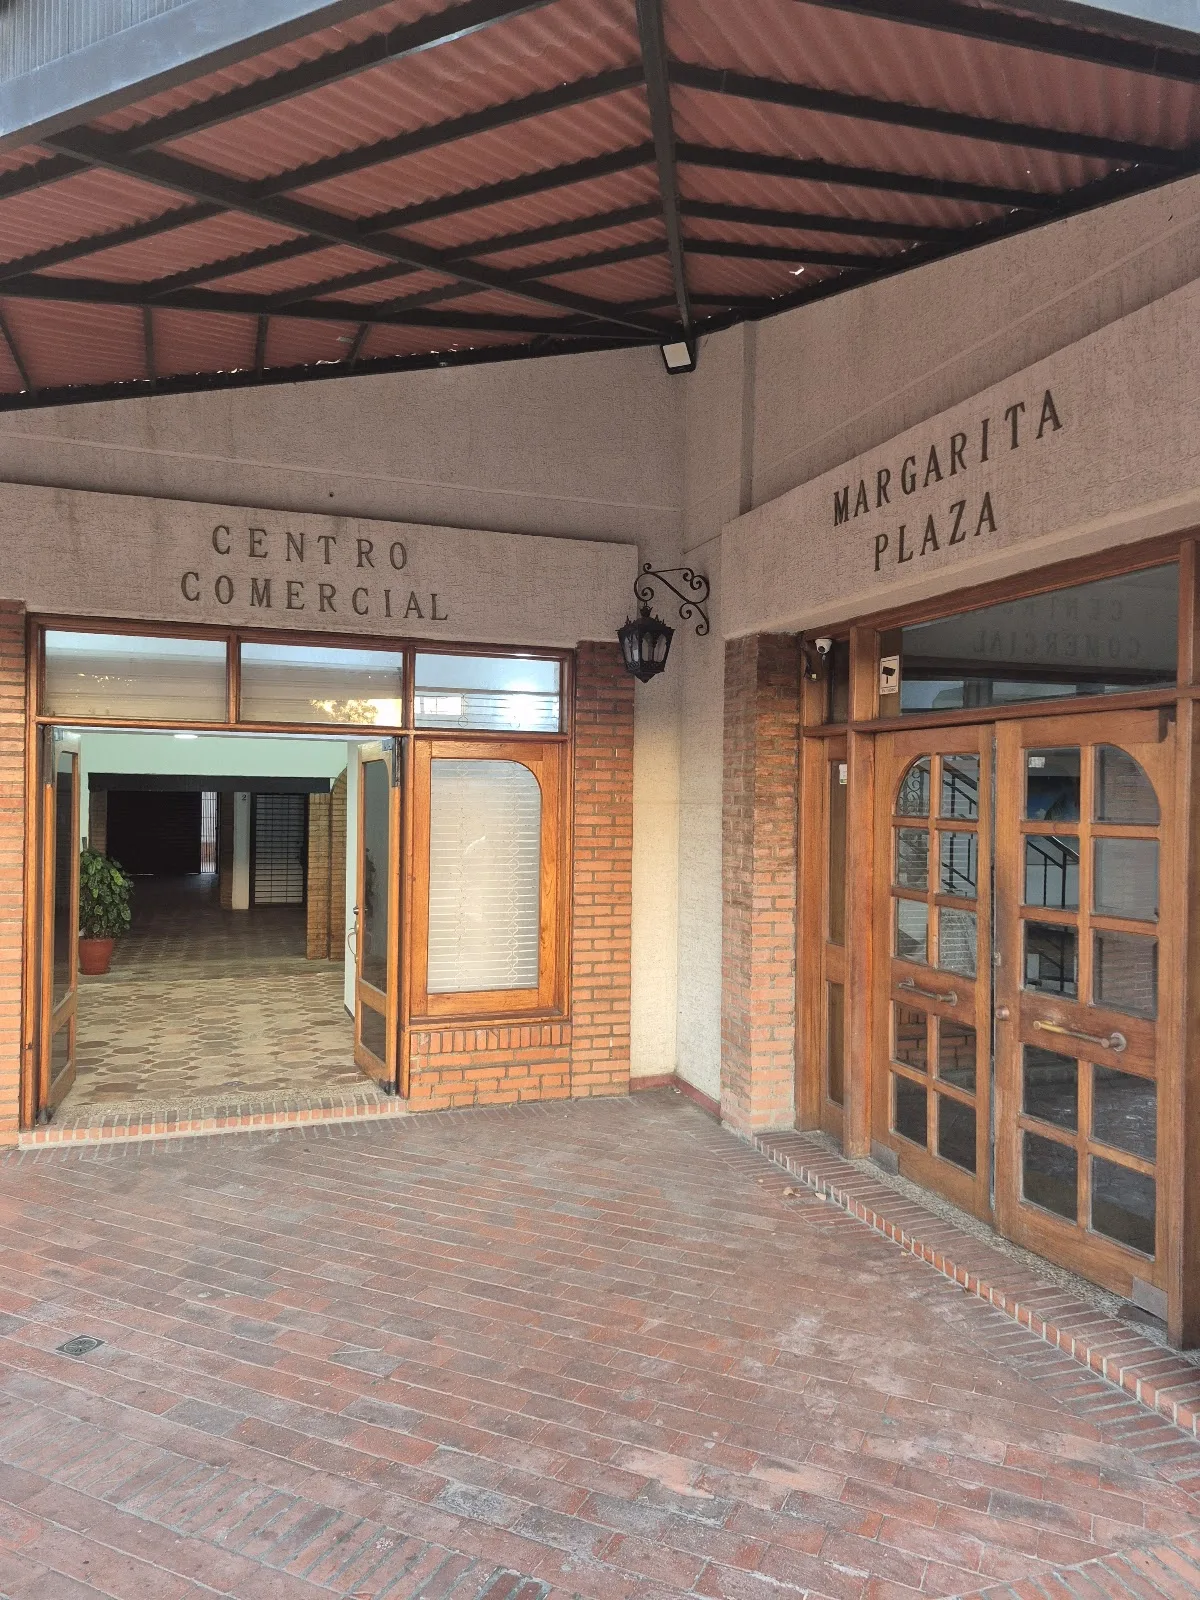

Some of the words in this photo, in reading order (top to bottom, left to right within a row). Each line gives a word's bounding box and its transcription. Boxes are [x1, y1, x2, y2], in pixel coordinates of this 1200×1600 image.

[833, 389, 1063, 527] MARGARITA
[212, 525, 408, 570] CENTRO
[873, 491, 998, 572] PLAZA
[181, 571, 448, 621] COMERCIAL
